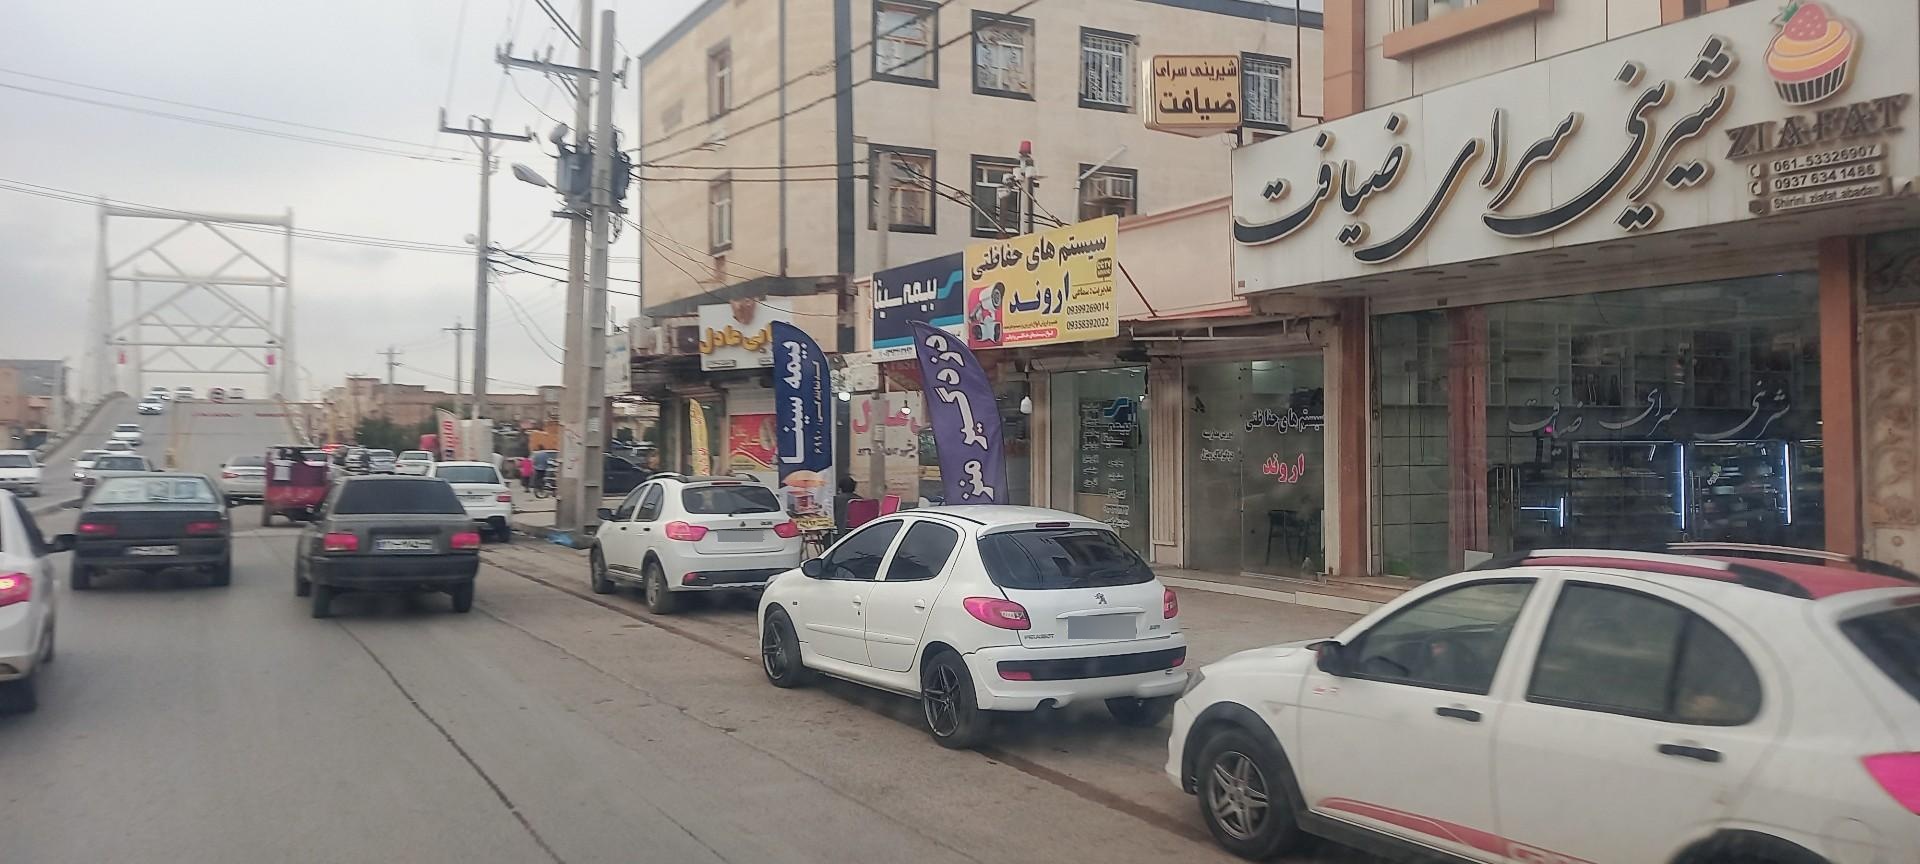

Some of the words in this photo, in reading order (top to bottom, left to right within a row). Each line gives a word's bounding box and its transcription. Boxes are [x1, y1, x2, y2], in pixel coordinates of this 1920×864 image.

[1156, 60, 1187, 81] سرای
[1190, 60, 1237, 81] شیرینی
[1159, 86, 1237, 120] ضیافت
[1480, 33, 1738, 238] شیرینی
[1725, 93, 1911, 160] ZIAFAT
[1232, 112, 1410, 246] ضیافت
[1353, 108, 1581, 264] سرای
[1775, 173, 1807, 190] 0937
[1811, 170, 1837, 183] 634
[971, 244, 1023, 280] حفاظتی
[1026, 235, 1056, 271] های
[1058, 234, 1107, 266] سیستم
[873, 279, 903, 319] سینا
[903, 278, 938, 312] بیمه
[1009, 272, 1070, 315] اروند
[1066, 302, 1110, 316] 09399269014
[1066, 317, 1109, 331] 09358392022
[782, 341, 807, 390] بیمه
[780, 396, 811, 464] سینا
[925, 335, 989, 450] دزدگیر
[959, 460, 994, 501] منز
[1245, 408, 1279, 433] حفاظتی
[1278, 408, 1298, 433] های
[1598, 388, 1678, 438] سرای
[1263, 453, 1305, 483] اروند
